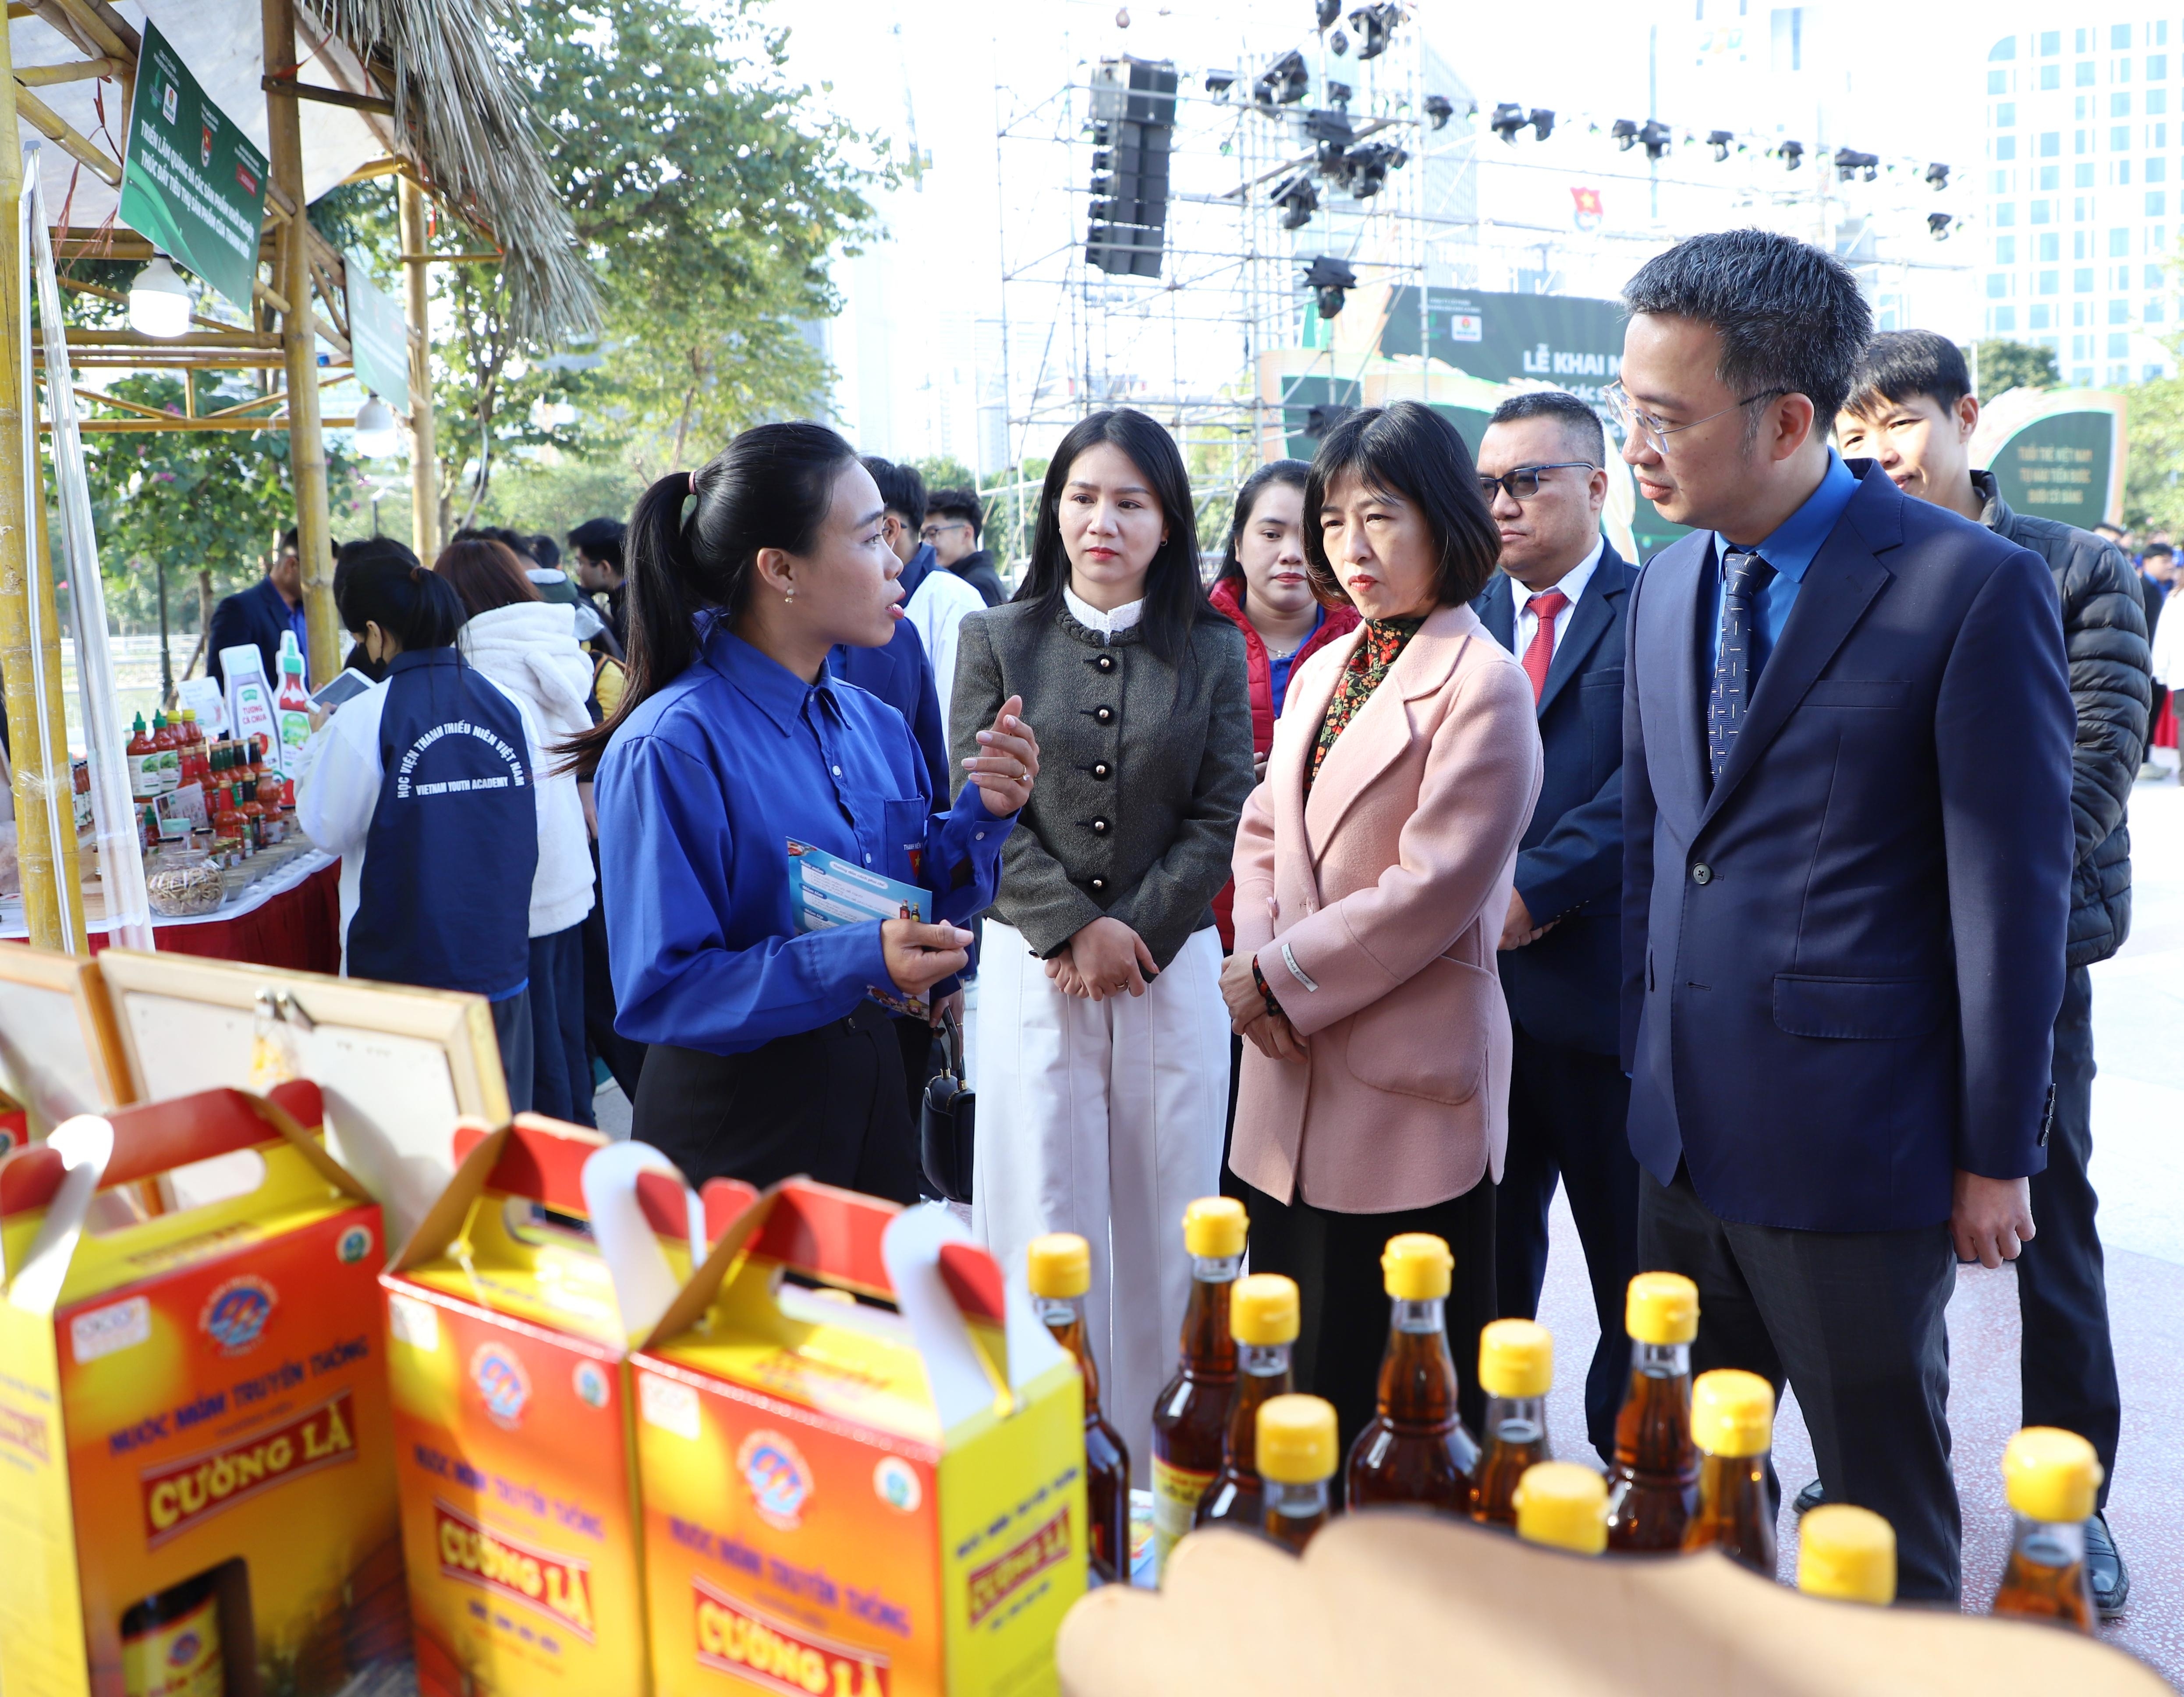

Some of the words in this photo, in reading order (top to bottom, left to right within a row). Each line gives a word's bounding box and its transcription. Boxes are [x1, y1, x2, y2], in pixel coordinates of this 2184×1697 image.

[141, 119, 158, 149] TRIỂN
[1523, 343, 1551, 373] LỄ
[1553, 351, 1605, 376] KHAI
[413, 725, 444, 752] THANH
[443, 719, 471, 735] THIẾU
[472, 725, 498, 746] NIÊN
[400, 749, 420, 774] VIỆN
[495, 740, 516, 762] VIỆT
[416, 781, 447, 796] VIETNAM
[447, 780, 471, 792] YOUTH
[472, 776, 508, 790] ACADEMY
[510, 761, 525, 787] NAM
[397, 776, 411, 799] HỌC
[150, 1437, 292, 1529] CƯỜNG
